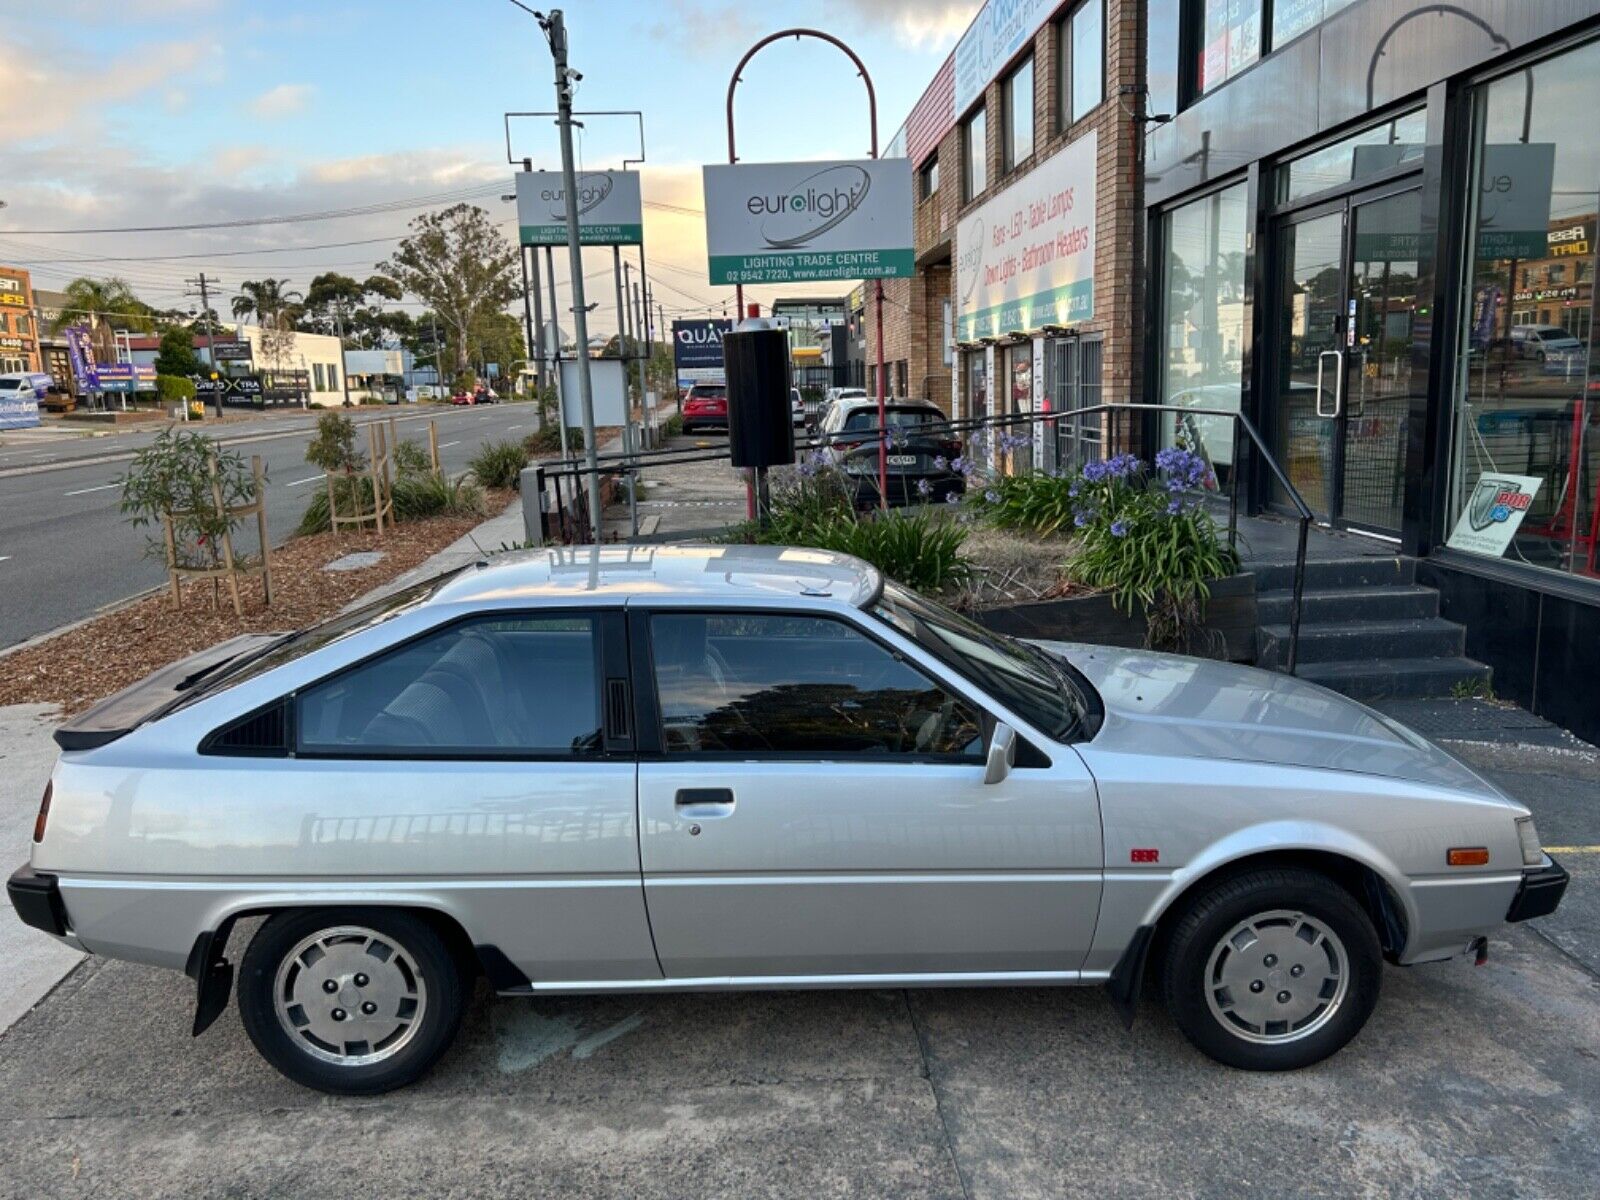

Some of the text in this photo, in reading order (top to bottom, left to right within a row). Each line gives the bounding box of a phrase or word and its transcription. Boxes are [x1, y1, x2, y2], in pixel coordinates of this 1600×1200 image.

[747, 187, 859, 218] eurolight
[1047, 187, 1074, 220] Lamps
[743, 252, 879, 269] LIGHTING TRADE CENTRE
[1022, 241, 1055, 272] Bathroom
[1056, 226, 1088, 258] Heaters
[726, 270, 739, 281] 02
[740, 269, 764, 281] 9542
[793, 265, 897, 278] www.eurolight.com.au
[679, 328, 731, 344] QUAY
